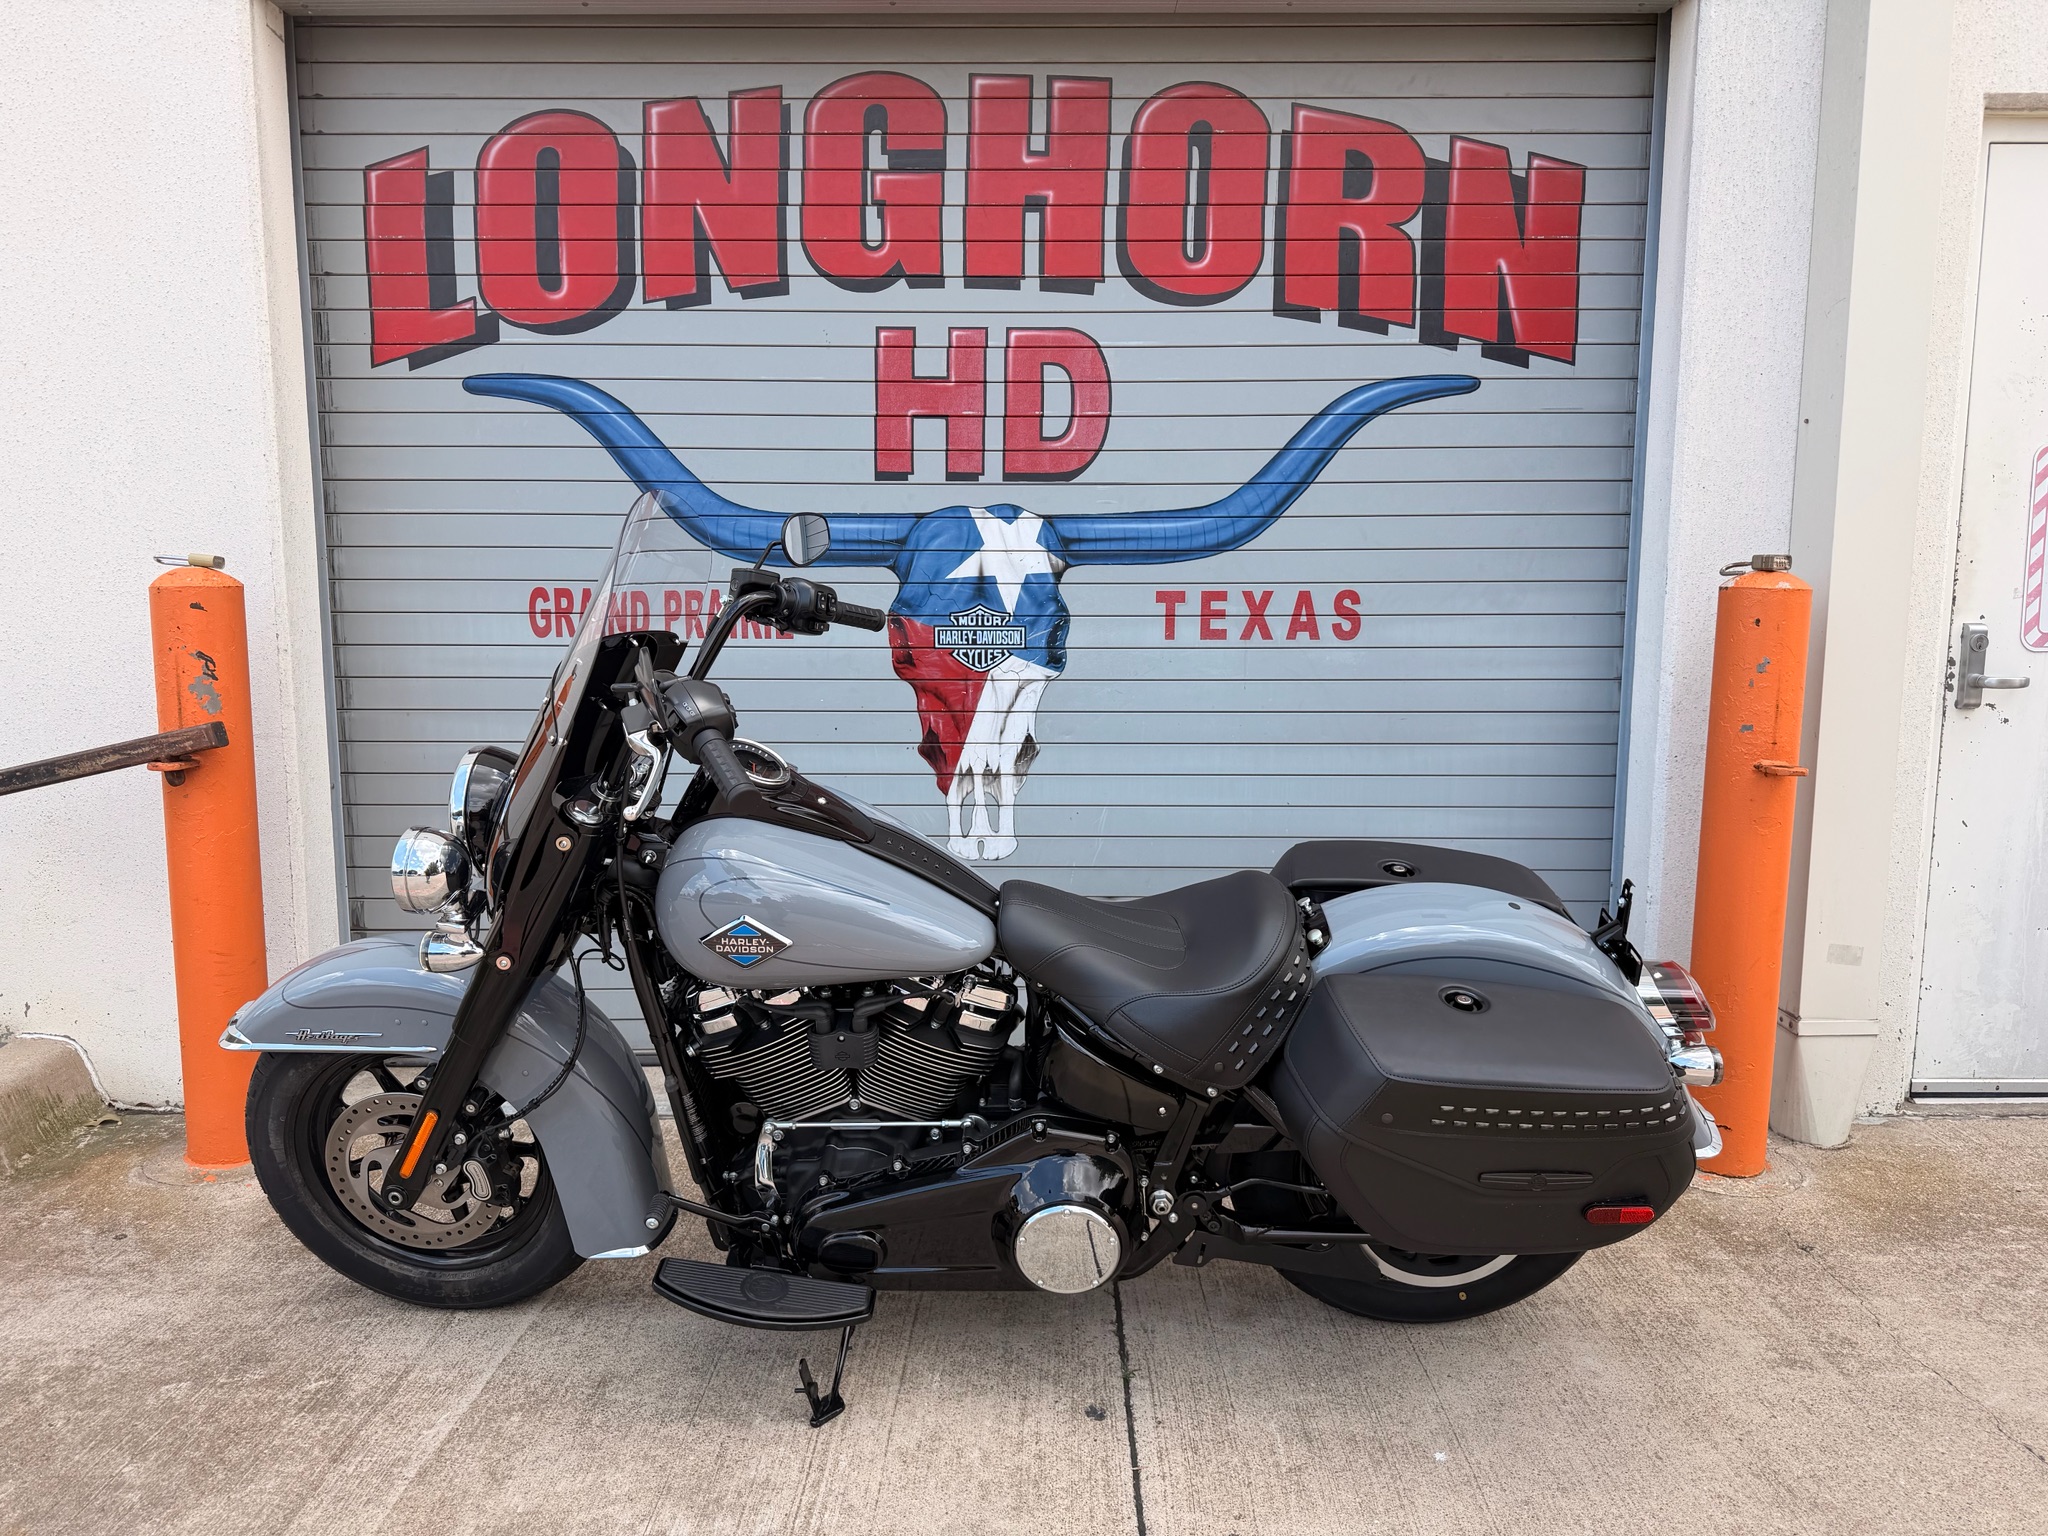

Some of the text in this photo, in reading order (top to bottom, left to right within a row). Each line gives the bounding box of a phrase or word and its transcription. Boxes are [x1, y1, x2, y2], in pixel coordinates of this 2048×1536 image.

[364, 70, 1586, 369] LONGHORN
[875, 326, 1111, 481] HD
[958, 610, 1002, 626] MOTOR
[1155, 589, 1361, 641] TEXAS
[939, 630, 1021, 645] HARLEY-DAVIDSON
[959, 649, 1003, 669] CYCLES
[715, 944, 774, 953] DAVIDSON
[721, 937, 770, 946] HARLEY-
